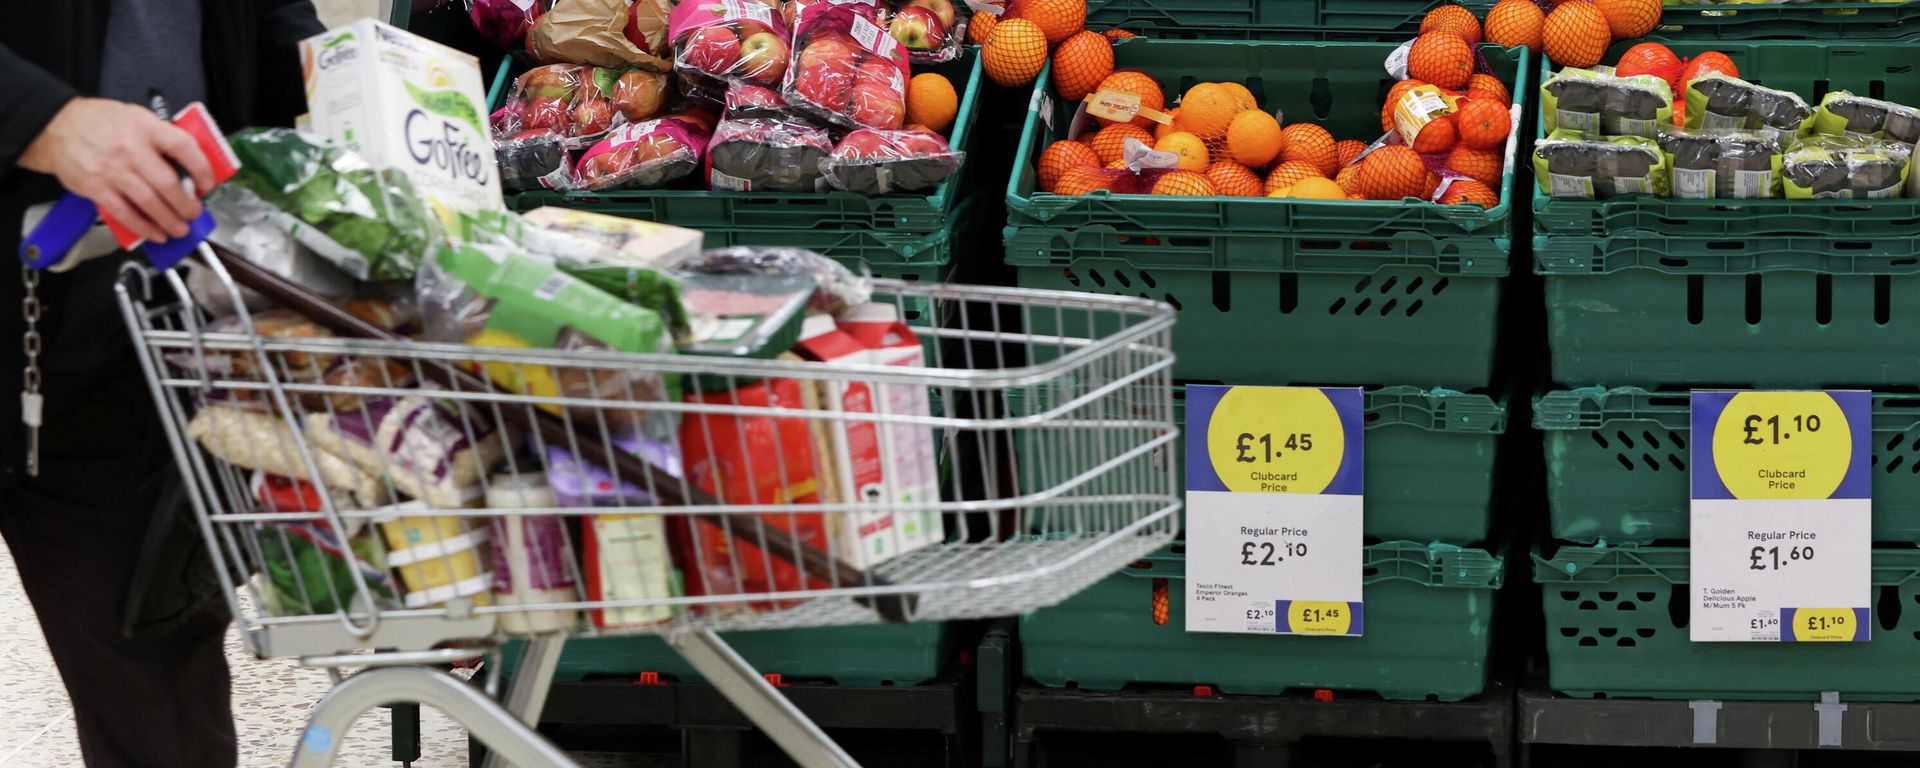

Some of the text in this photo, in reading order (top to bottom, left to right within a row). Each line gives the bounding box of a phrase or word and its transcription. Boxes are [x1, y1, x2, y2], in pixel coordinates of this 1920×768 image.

[405, 108, 488, 185] GoFree
[1743, 415, 1821, 445] £1.10
[1236, 432, 1312, 463] £1.45
[1250, 471, 1298, 481] Clubcard
[1758, 469, 1806, 479] Clubcard
[1261, 482, 1288, 492] Price
[1768, 480, 1796, 490] Price
[1240, 526, 1308, 538] Regular Price
[1747, 530, 1816, 542] Regular Price
[1241, 541, 1307, 566] £2.10
[1750, 545, 1814, 570] £1.60
[1246, 609, 1274, 620] £2.10
[1302, 608, 1339, 622] £1.45
[1750, 618, 1779, 629] £1.60
[1807, 616, 1845, 630] £1.10
